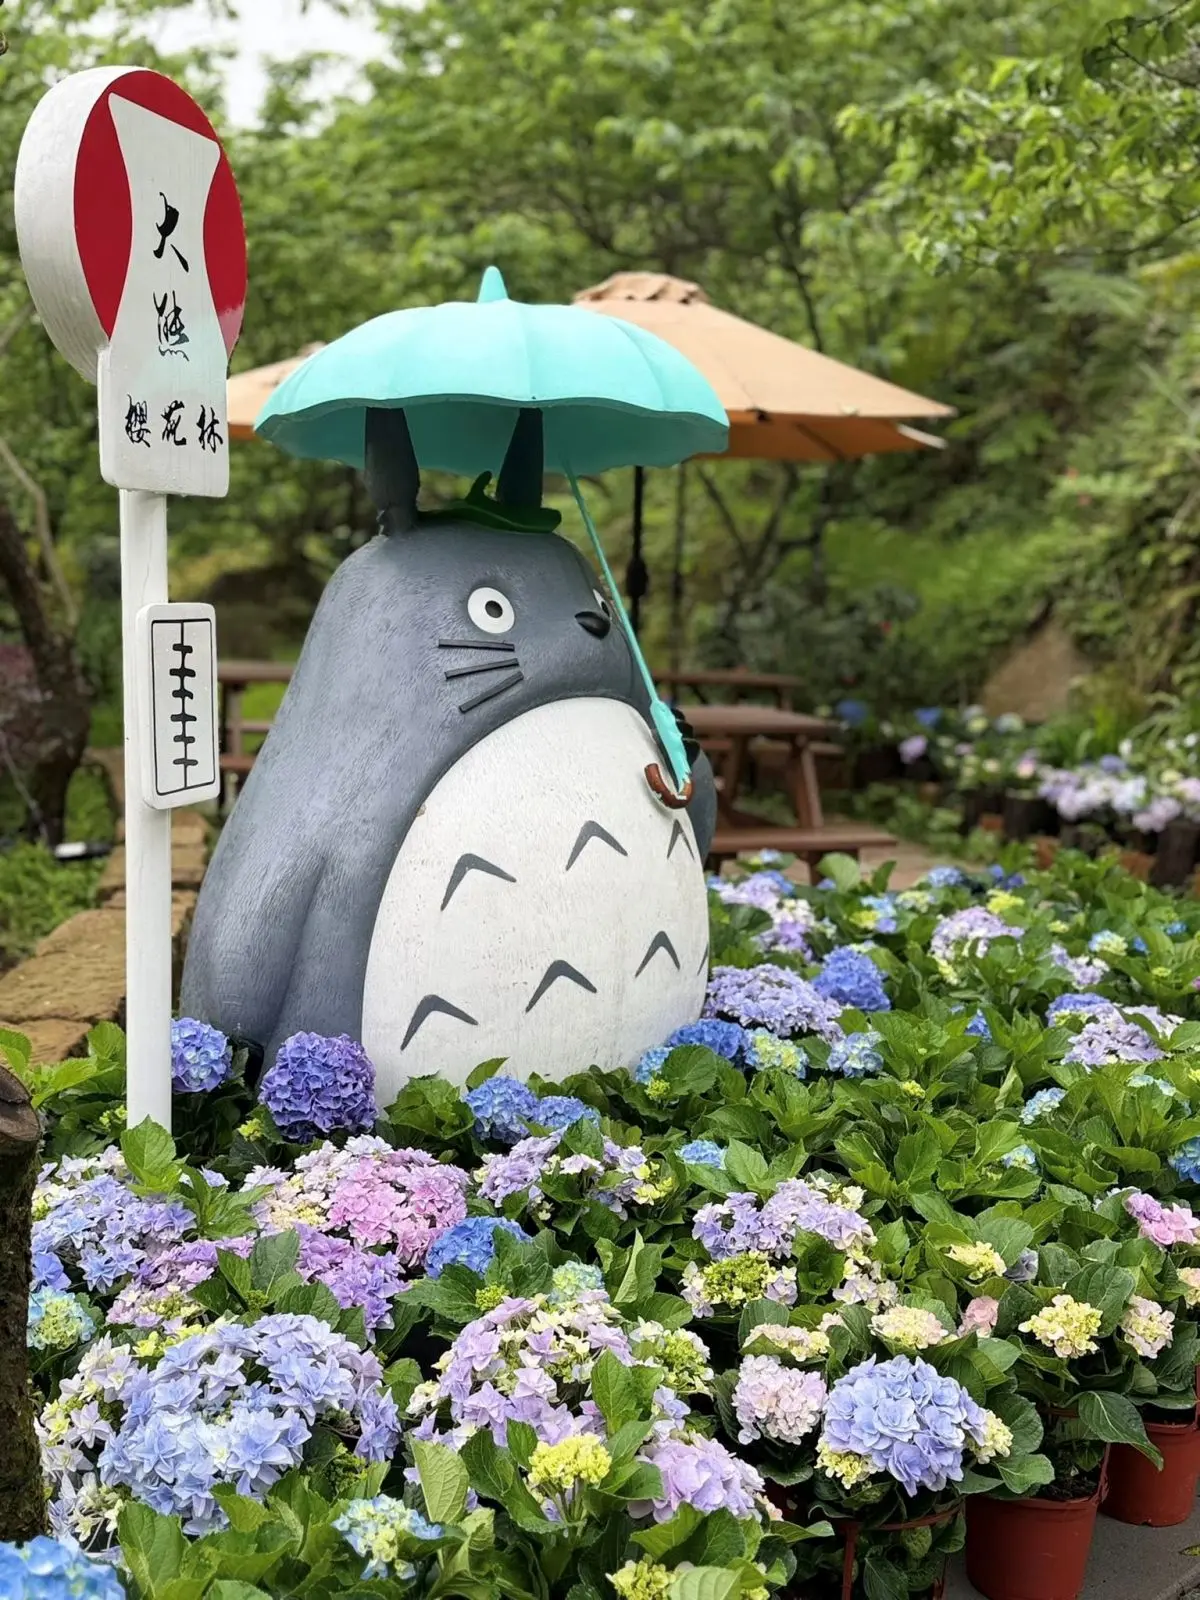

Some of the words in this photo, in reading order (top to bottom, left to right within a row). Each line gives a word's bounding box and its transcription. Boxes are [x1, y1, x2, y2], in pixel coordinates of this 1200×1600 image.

[152, 191, 190, 362] 大熊
[124, 394, 224, 454] 櫻花林
